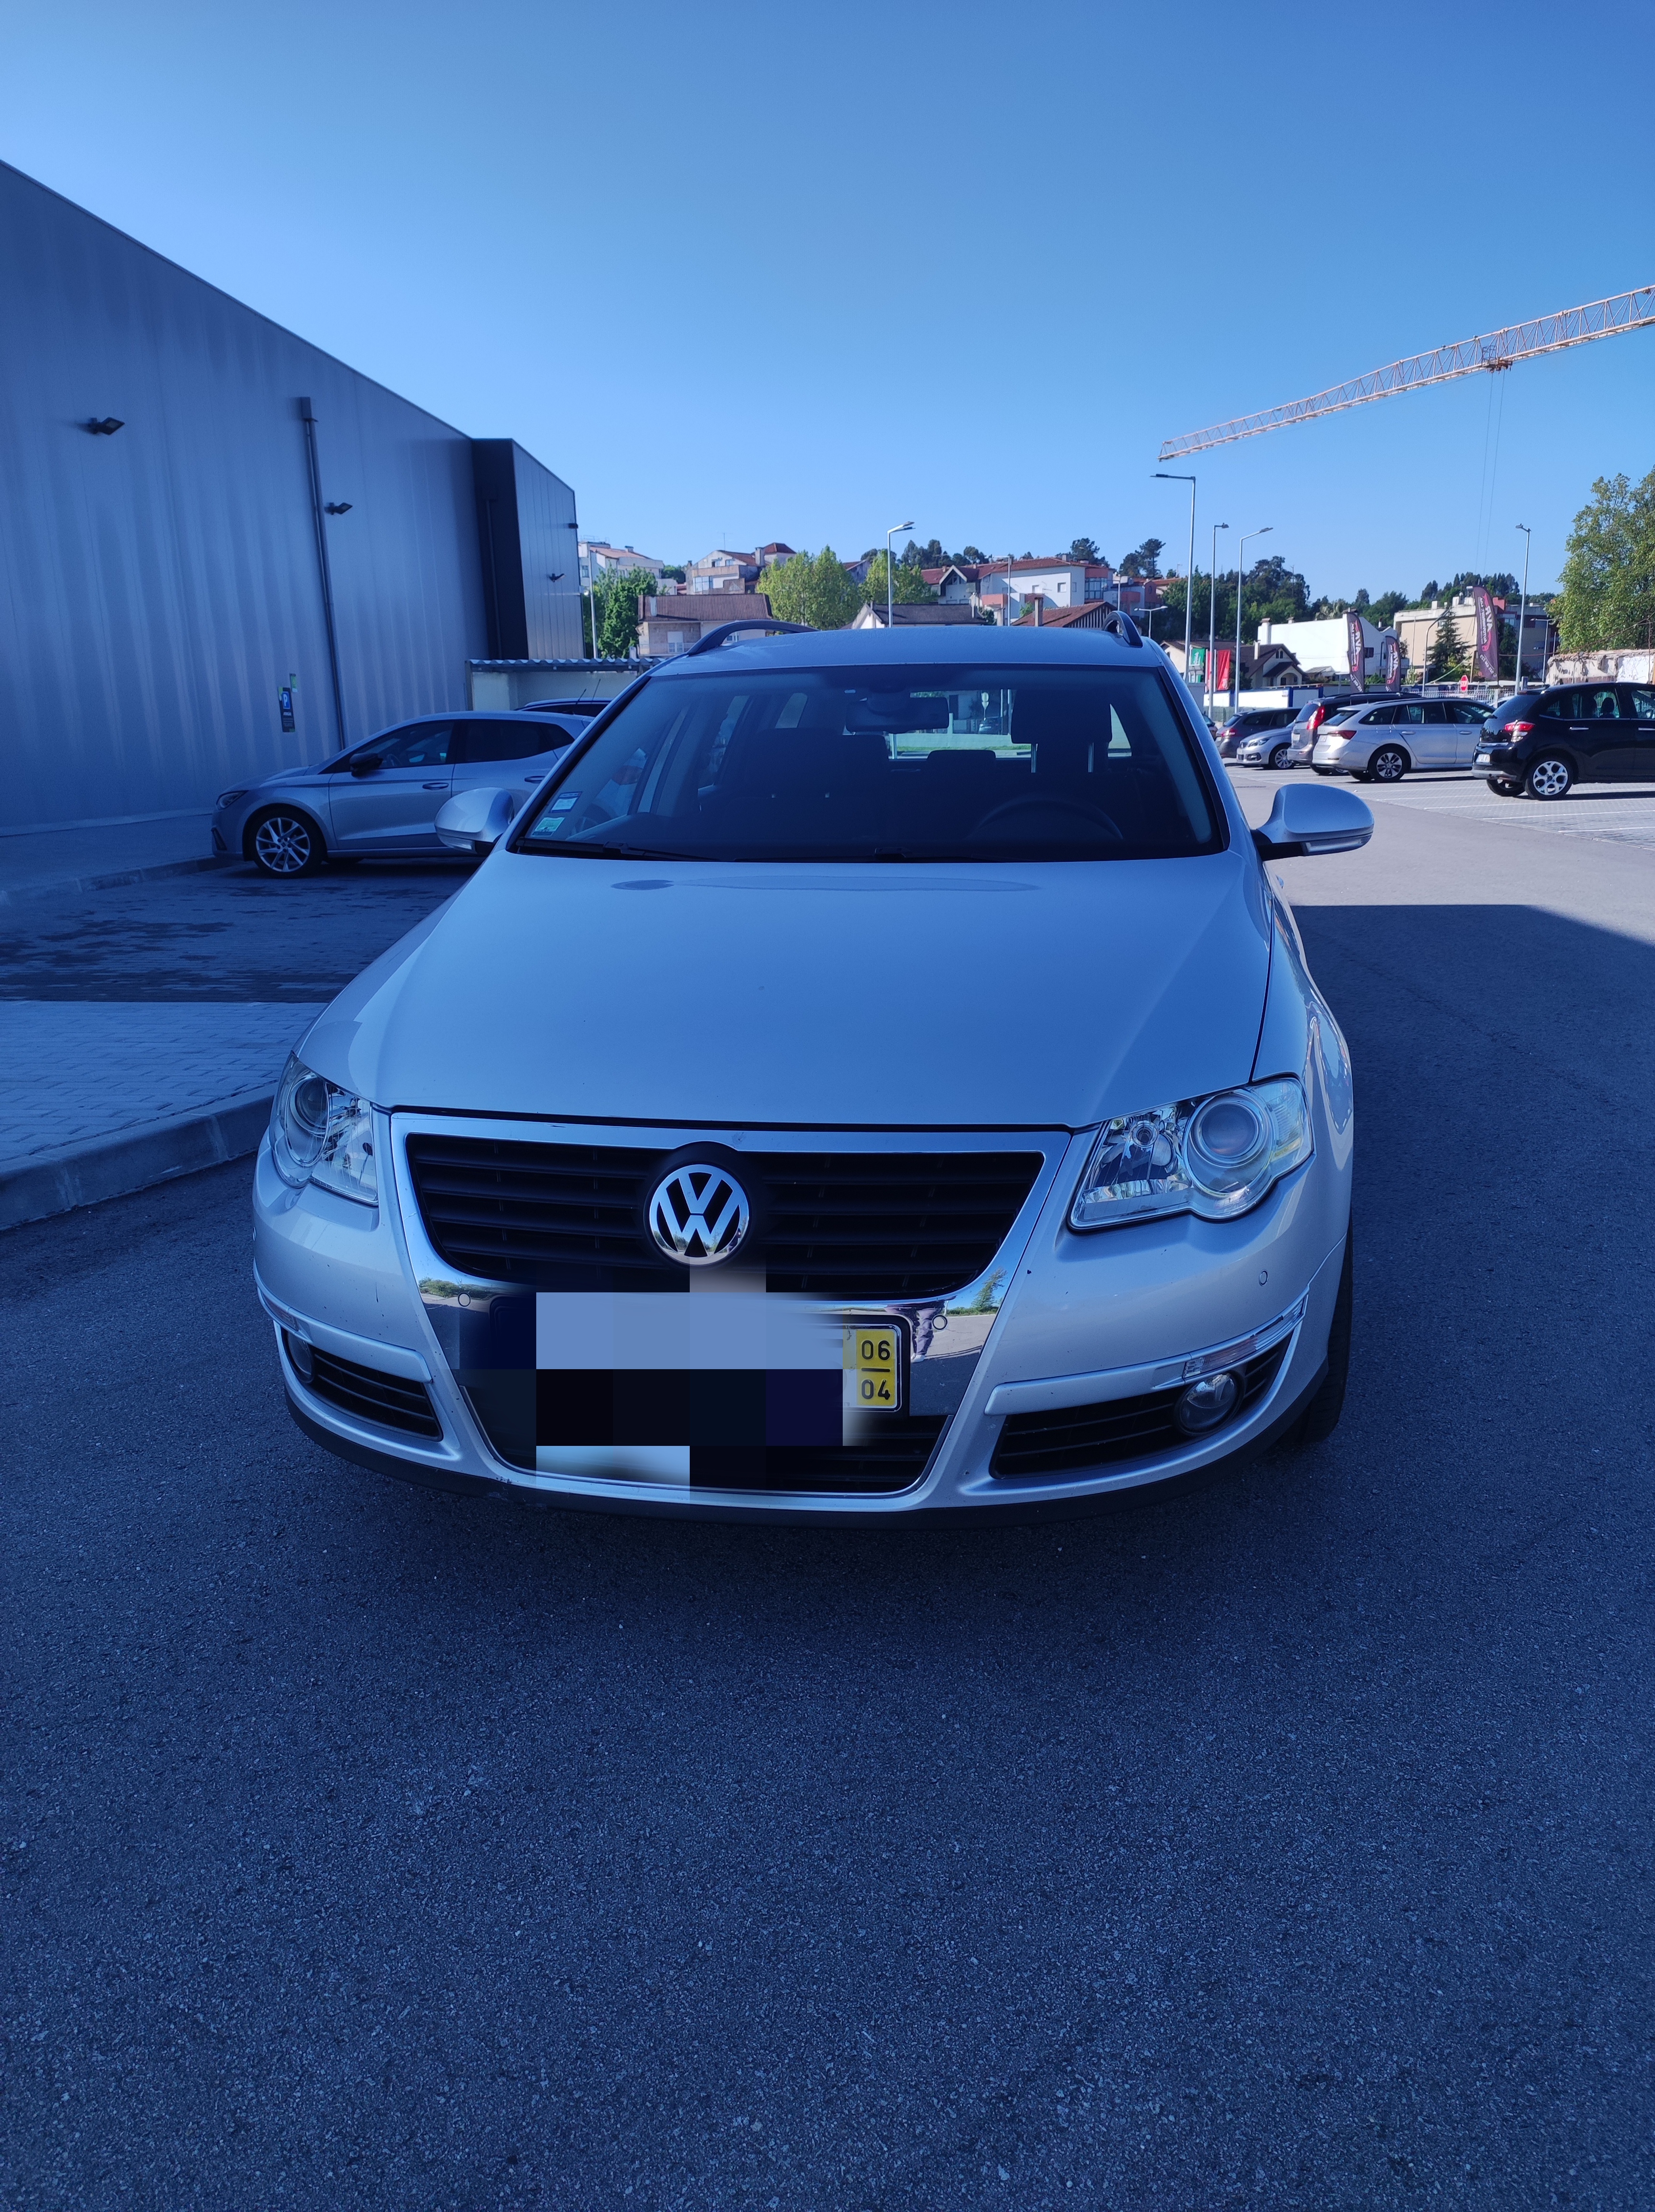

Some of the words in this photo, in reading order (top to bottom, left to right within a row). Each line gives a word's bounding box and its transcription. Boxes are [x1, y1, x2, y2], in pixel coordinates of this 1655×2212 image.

[283, 694, 287, 707] P
[654, 1170, 744, 1260] VW
[861, 1340, 890, 1361] 06
[861, 1379, 890, 1400] 04
